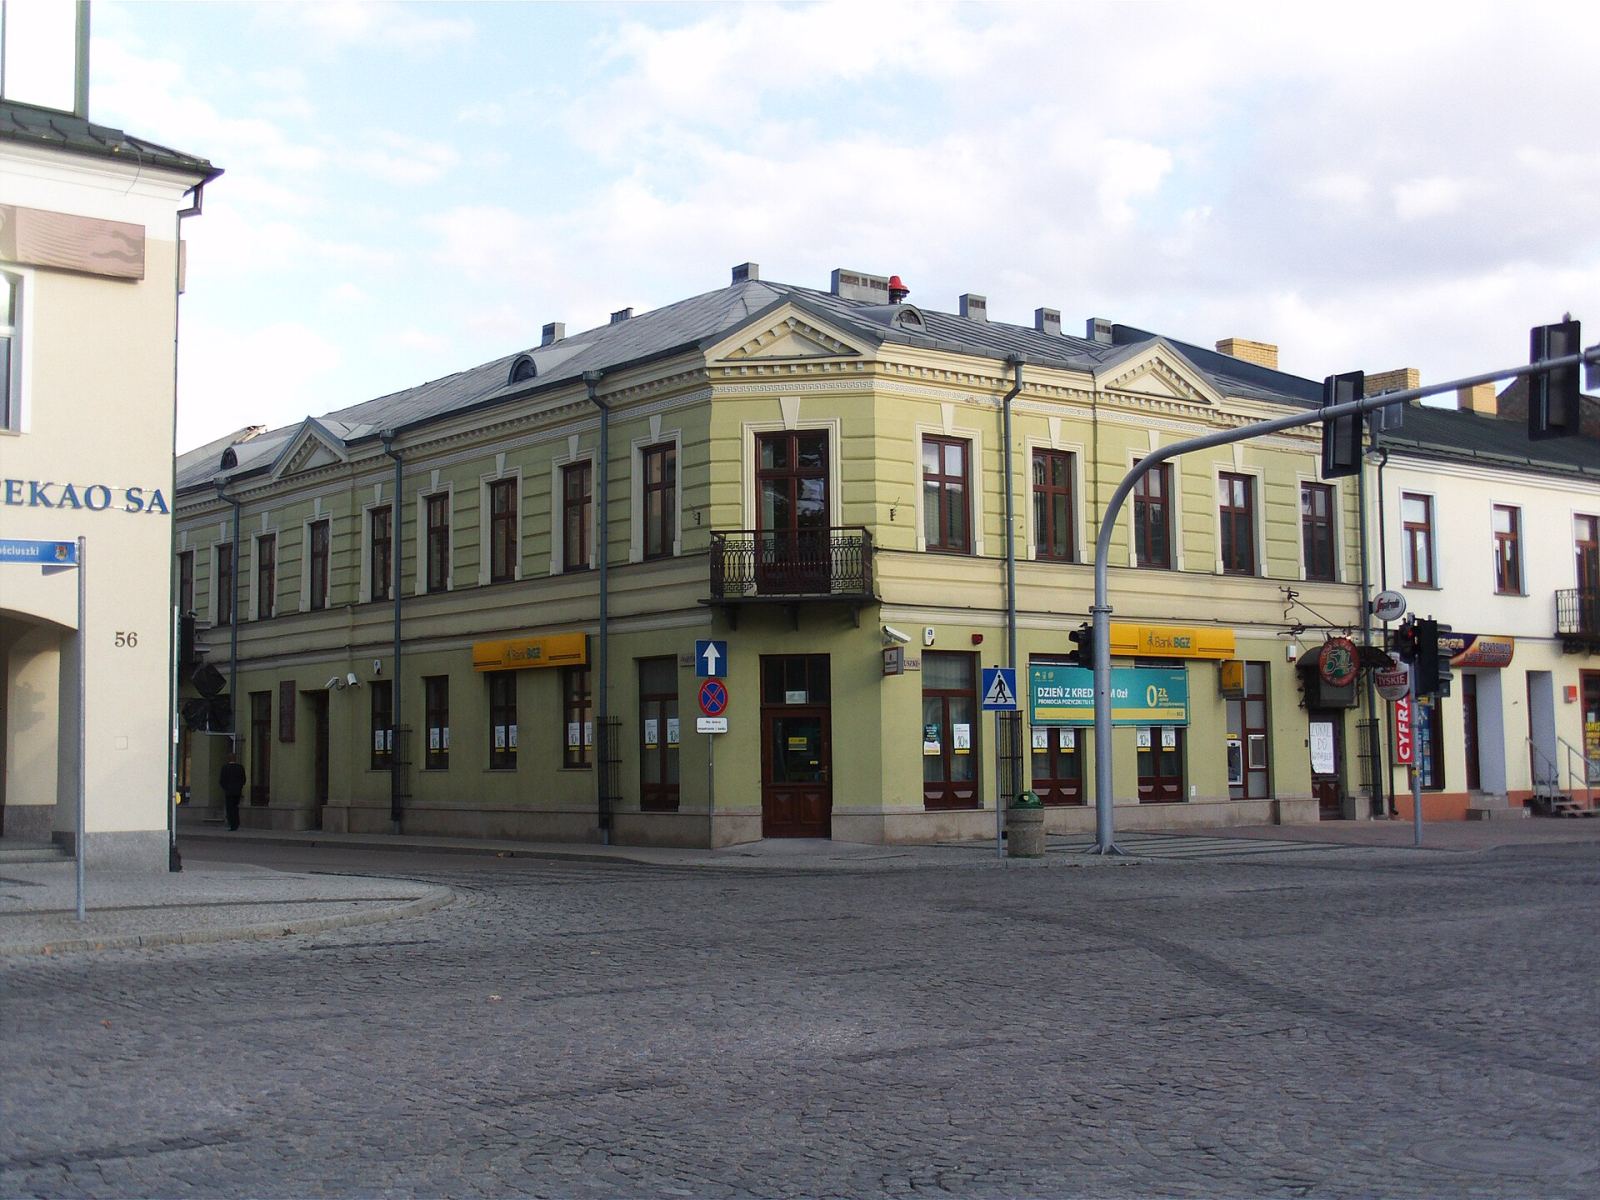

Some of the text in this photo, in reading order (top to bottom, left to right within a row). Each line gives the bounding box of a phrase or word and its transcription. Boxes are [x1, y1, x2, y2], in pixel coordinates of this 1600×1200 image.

[0, 478, 170, 514] EKAO SA
[114, 631, 138, 648] 56
[1154, 636, 1173, 648] Bank
[1378, 674, 1405, 685] TYSKIE
[1037, 685, 1063, 698] DZIEŃ
[1064, 687, 1071, 698] Z
[1146, 684, 1158, 707] 0
